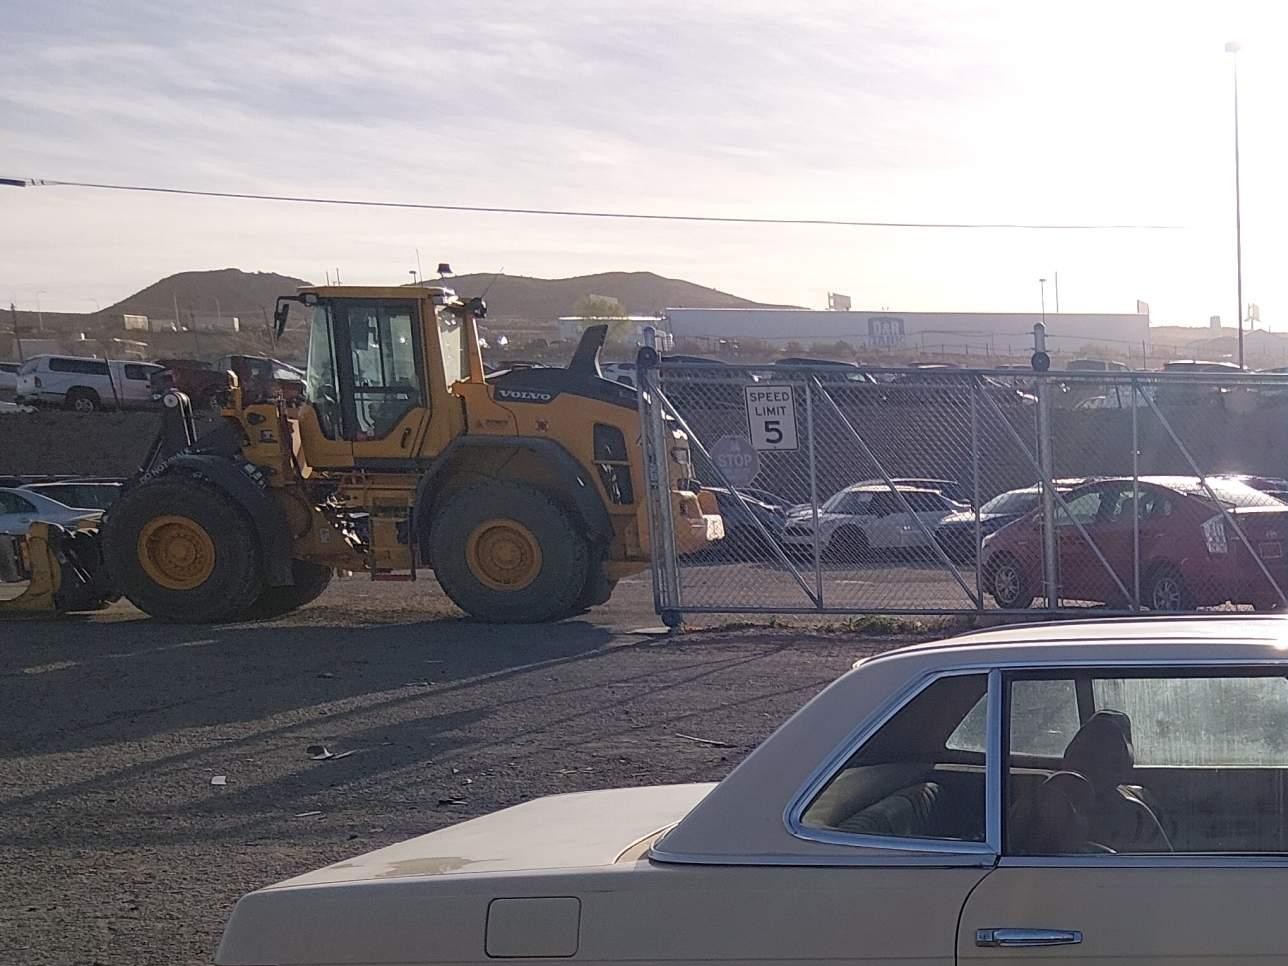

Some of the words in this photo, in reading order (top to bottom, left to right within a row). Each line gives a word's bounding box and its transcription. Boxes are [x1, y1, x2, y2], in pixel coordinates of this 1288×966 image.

[499, 389, 550, 401] VOLVO
[750, 391, 790, 402] SPEED
[755, 405, 787, 416] LIMIT
[764, 420, 783, 444] 5
[718, 453, 752, 468] STOP
